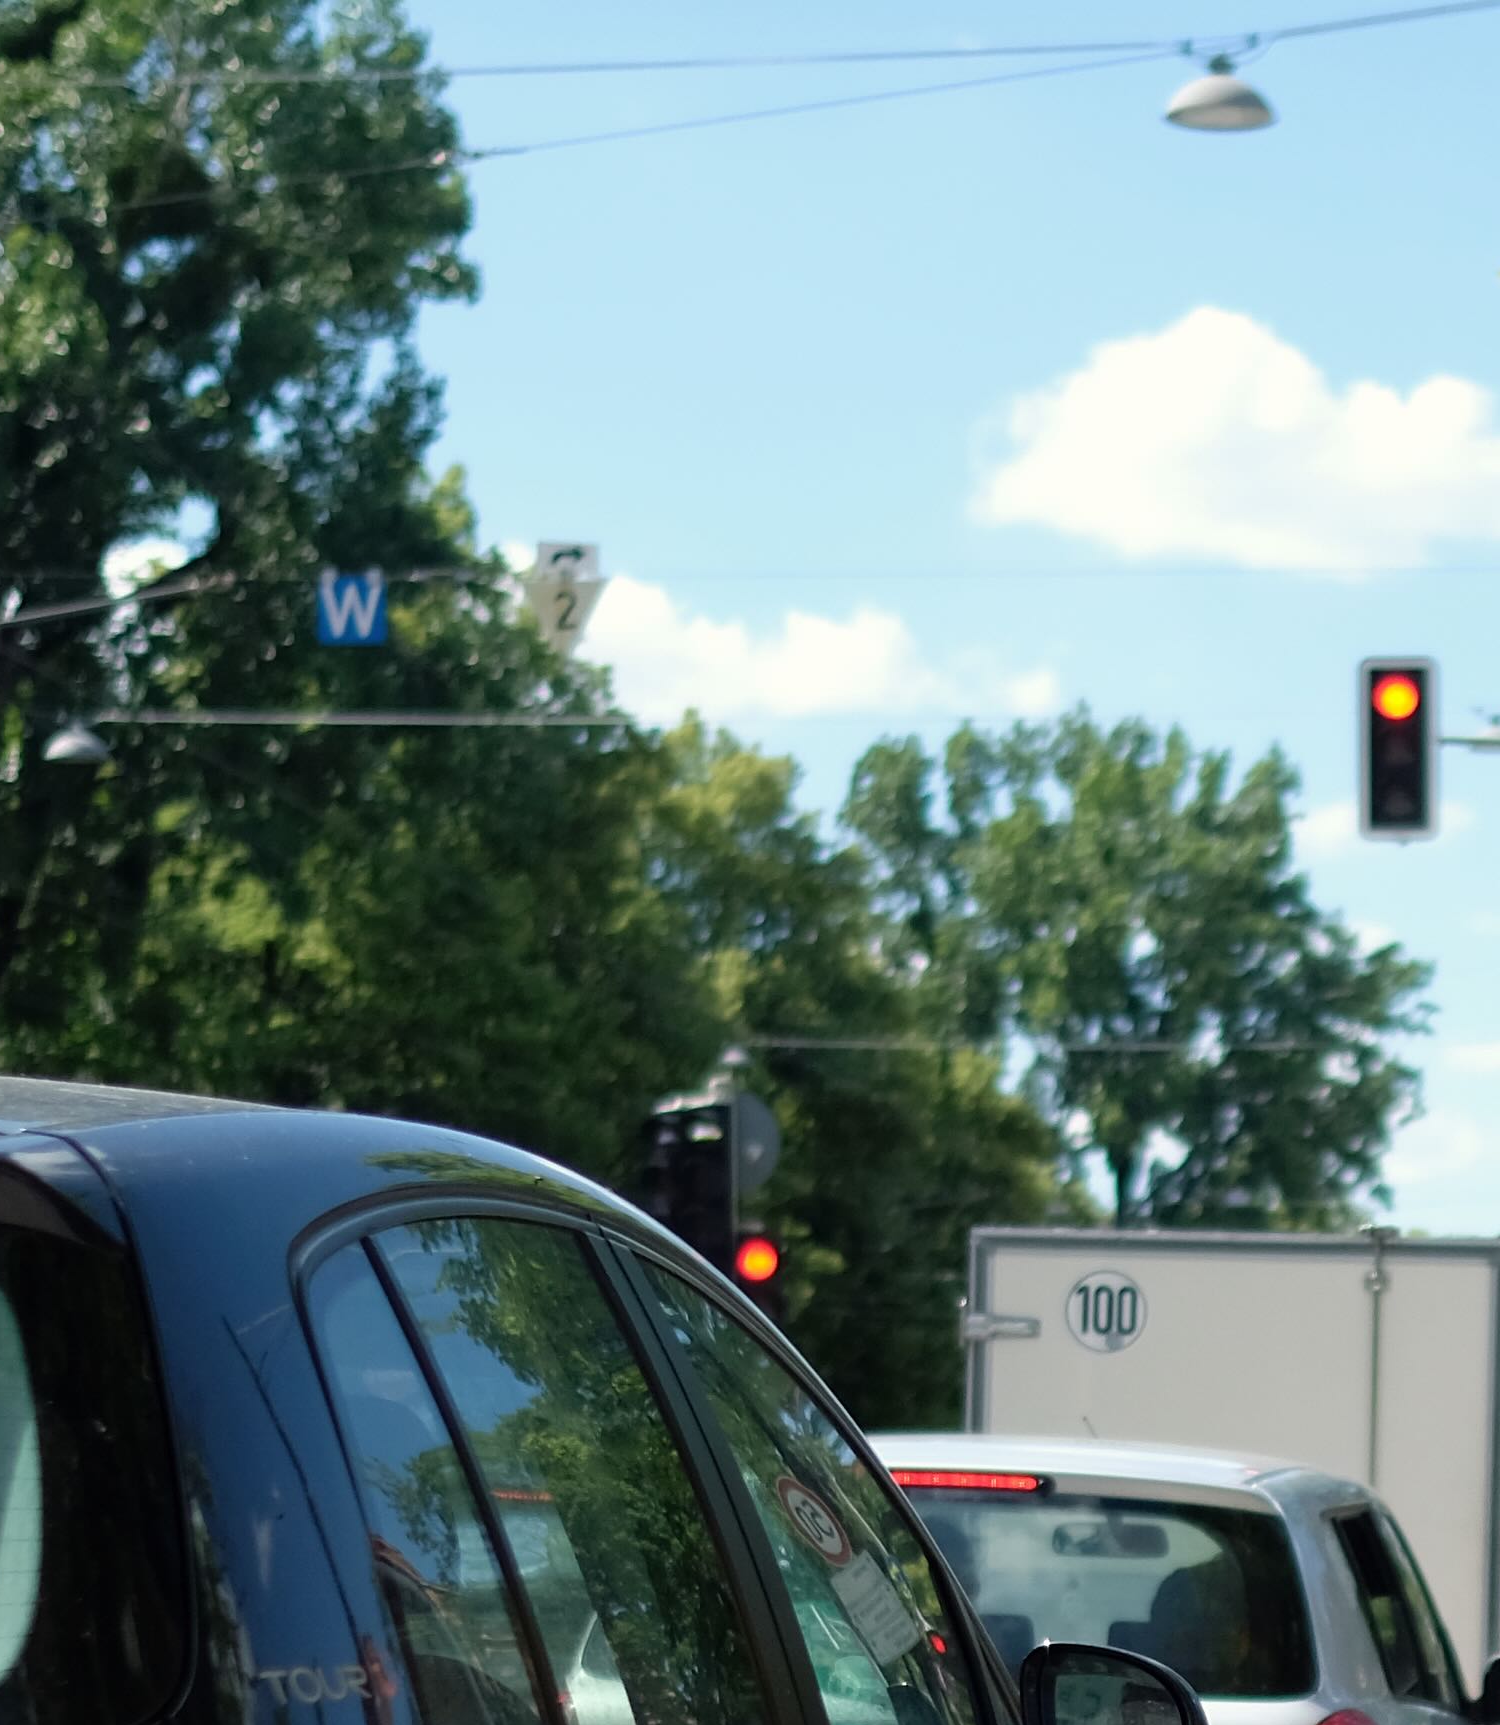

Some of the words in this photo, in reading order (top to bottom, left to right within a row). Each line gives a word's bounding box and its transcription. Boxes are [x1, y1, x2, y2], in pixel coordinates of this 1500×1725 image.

[319, 567, 383, 639] W
[1076, 1285, 1137, 1335] 100
[259, 1665, 373, 1705] TOUR
